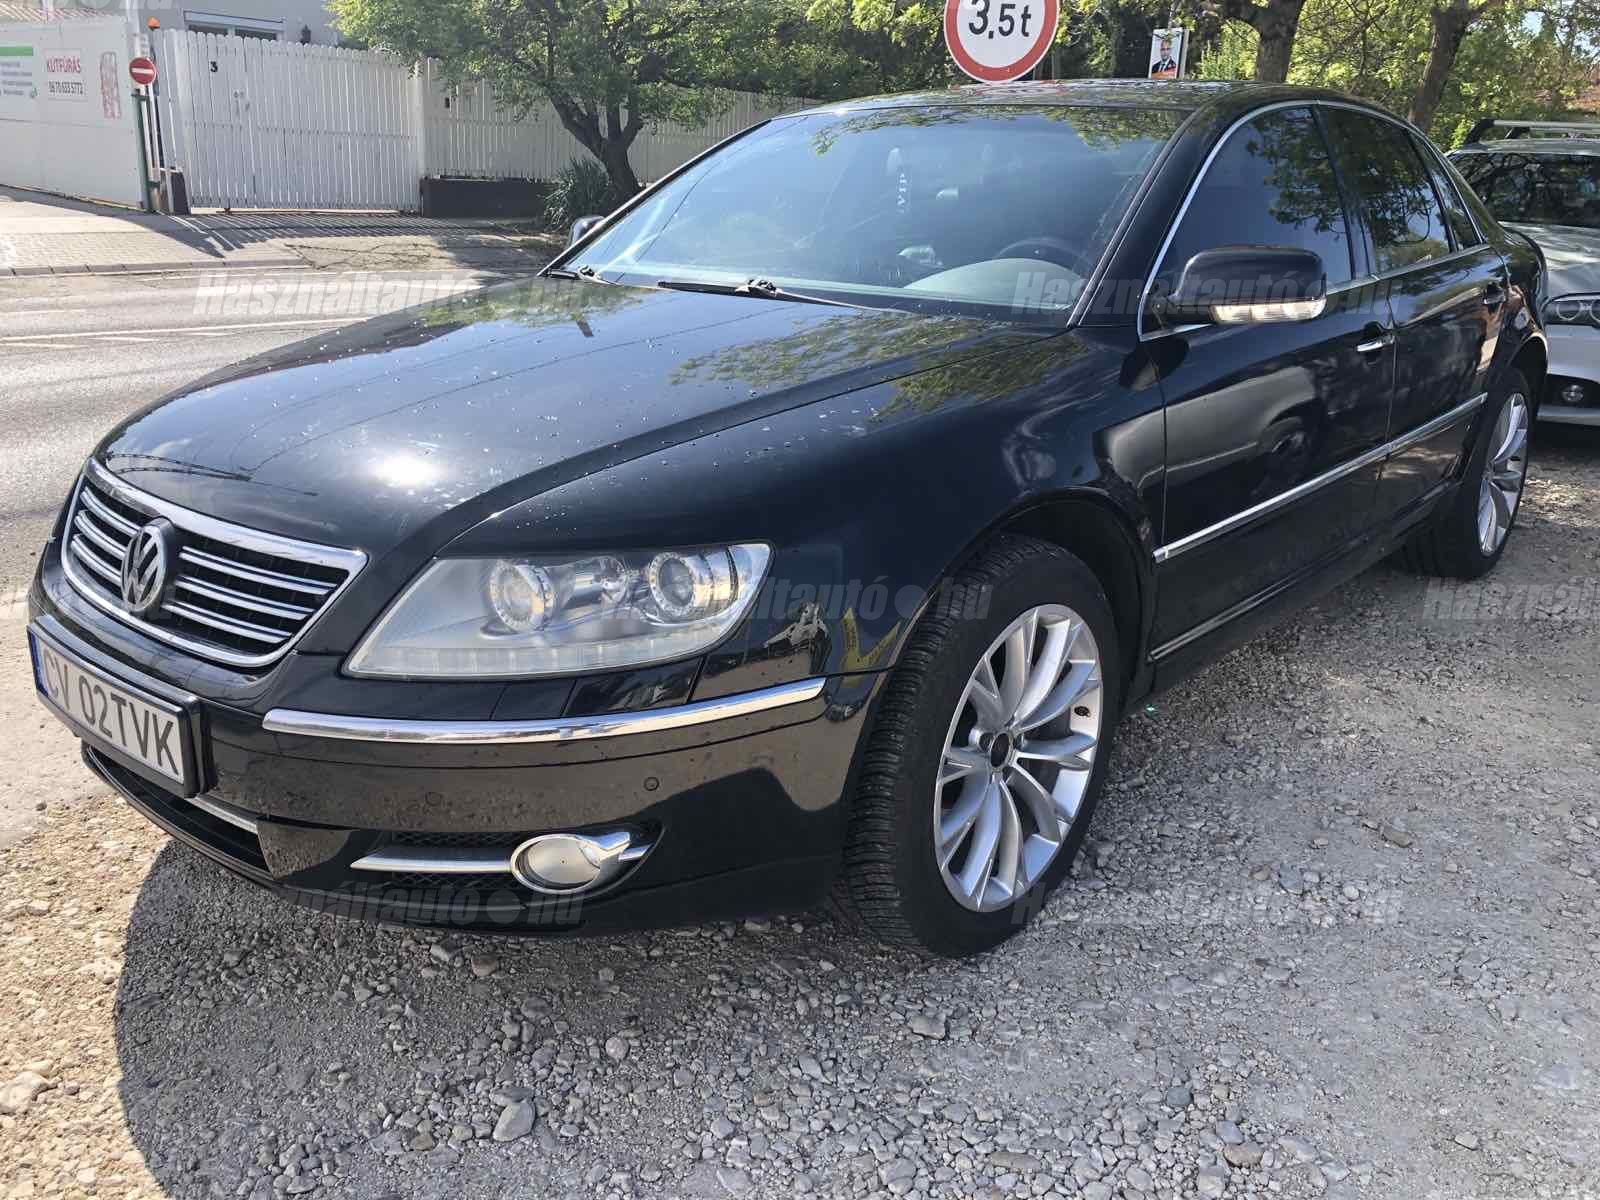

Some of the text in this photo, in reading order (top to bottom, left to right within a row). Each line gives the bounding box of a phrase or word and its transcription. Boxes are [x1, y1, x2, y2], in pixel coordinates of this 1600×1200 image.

[968, 0, 1031, 39] 3,5 t
[210, 61, 218, 73] 3
[43, 650, 70, 711] CV
